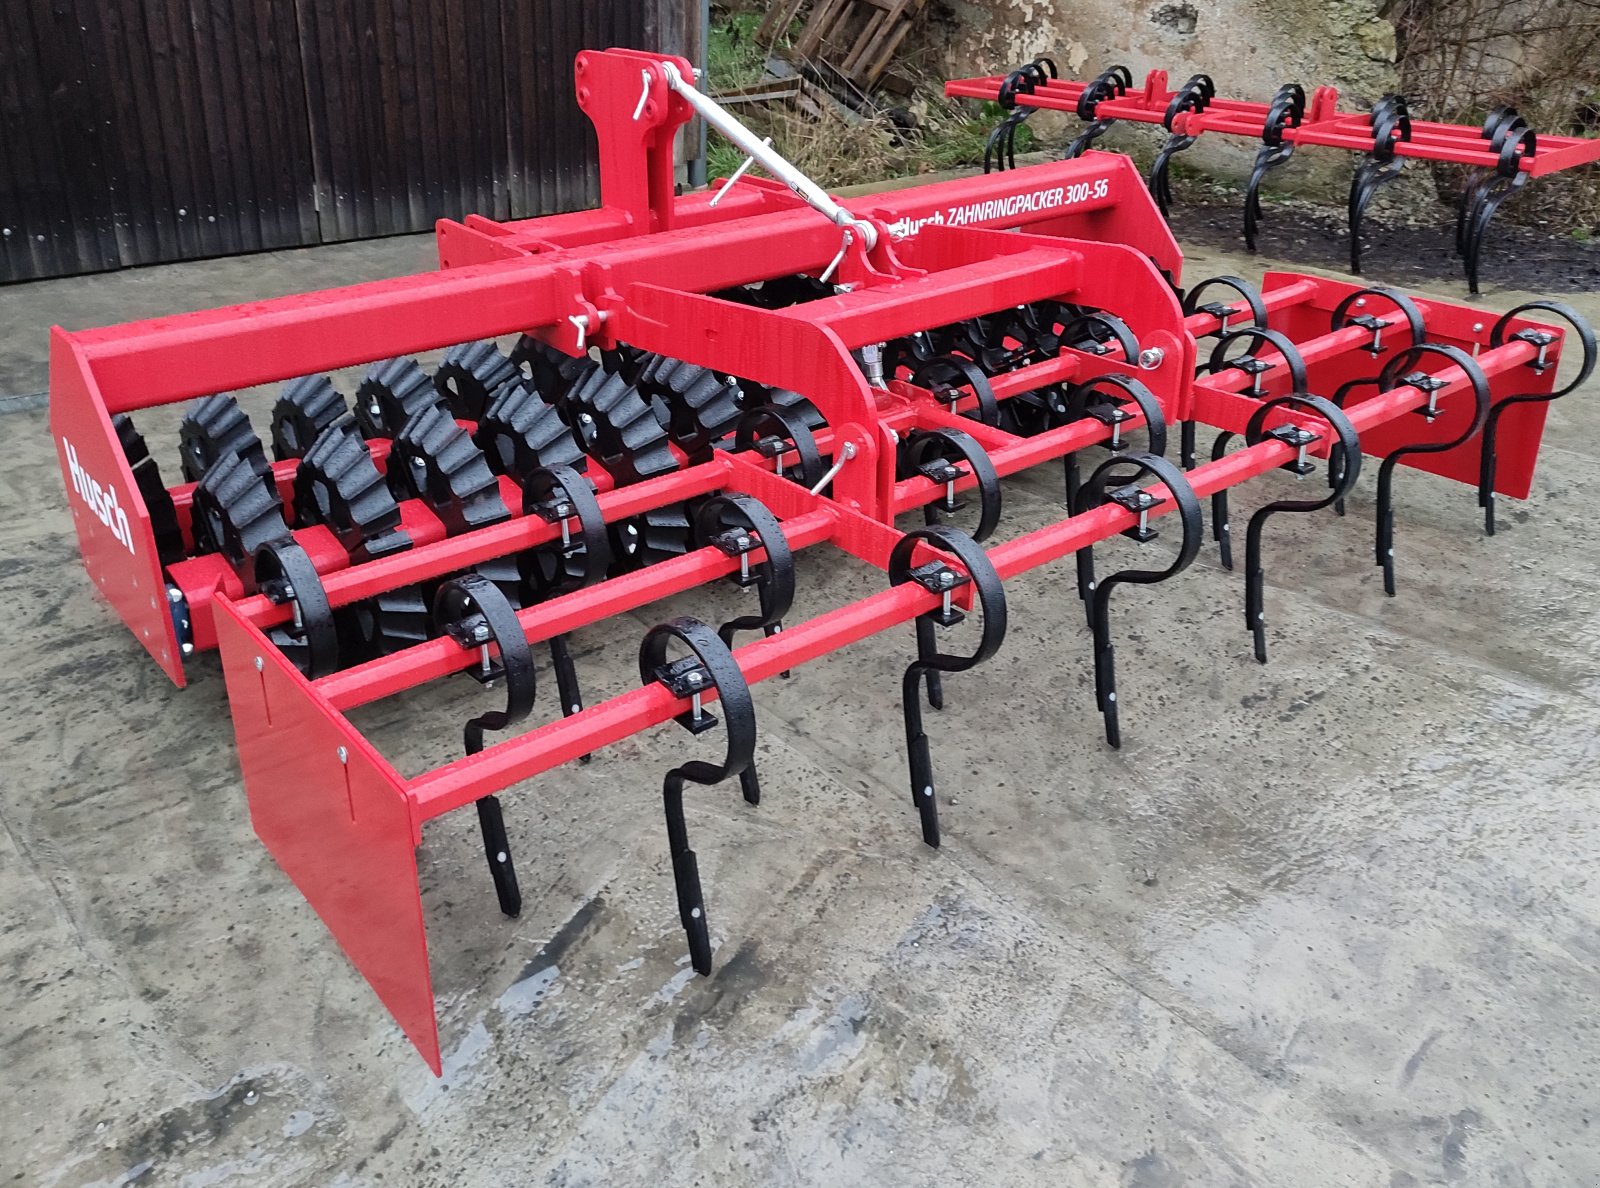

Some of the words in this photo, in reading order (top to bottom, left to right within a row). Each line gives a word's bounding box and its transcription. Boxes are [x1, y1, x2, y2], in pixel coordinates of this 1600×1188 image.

[947, 188, 1063, 226] ZAHNRINGPACKER
[1064, 179, 1108, 205] 300-56
[63, 436, 135, 556] Husch
